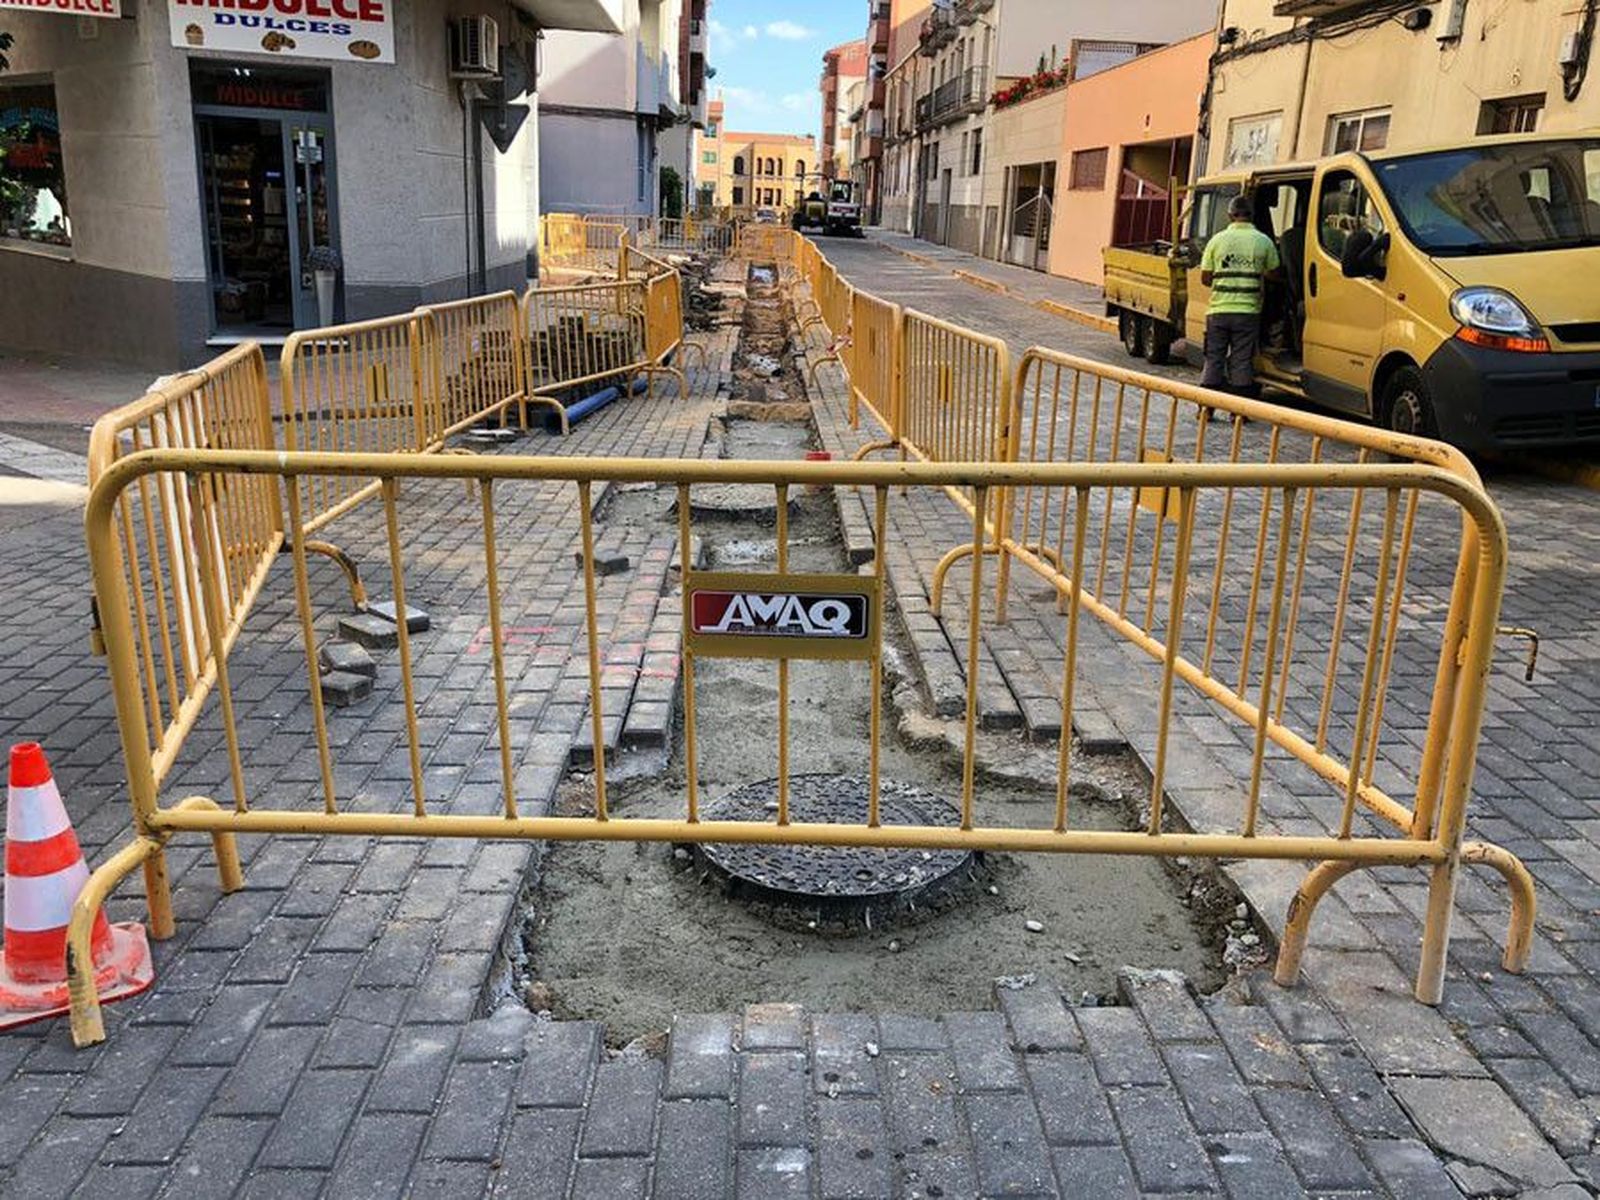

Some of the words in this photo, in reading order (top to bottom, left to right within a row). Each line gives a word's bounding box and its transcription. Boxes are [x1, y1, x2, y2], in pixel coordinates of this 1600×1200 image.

[0, 0, 114, 13] ULCE
[176, 0, 385, 22] ULCE
[214, 12, 351, 36] DULCES
[216, 83, 305, 108] MIDULCE
[701, 594, 851, 634] AMAQ
